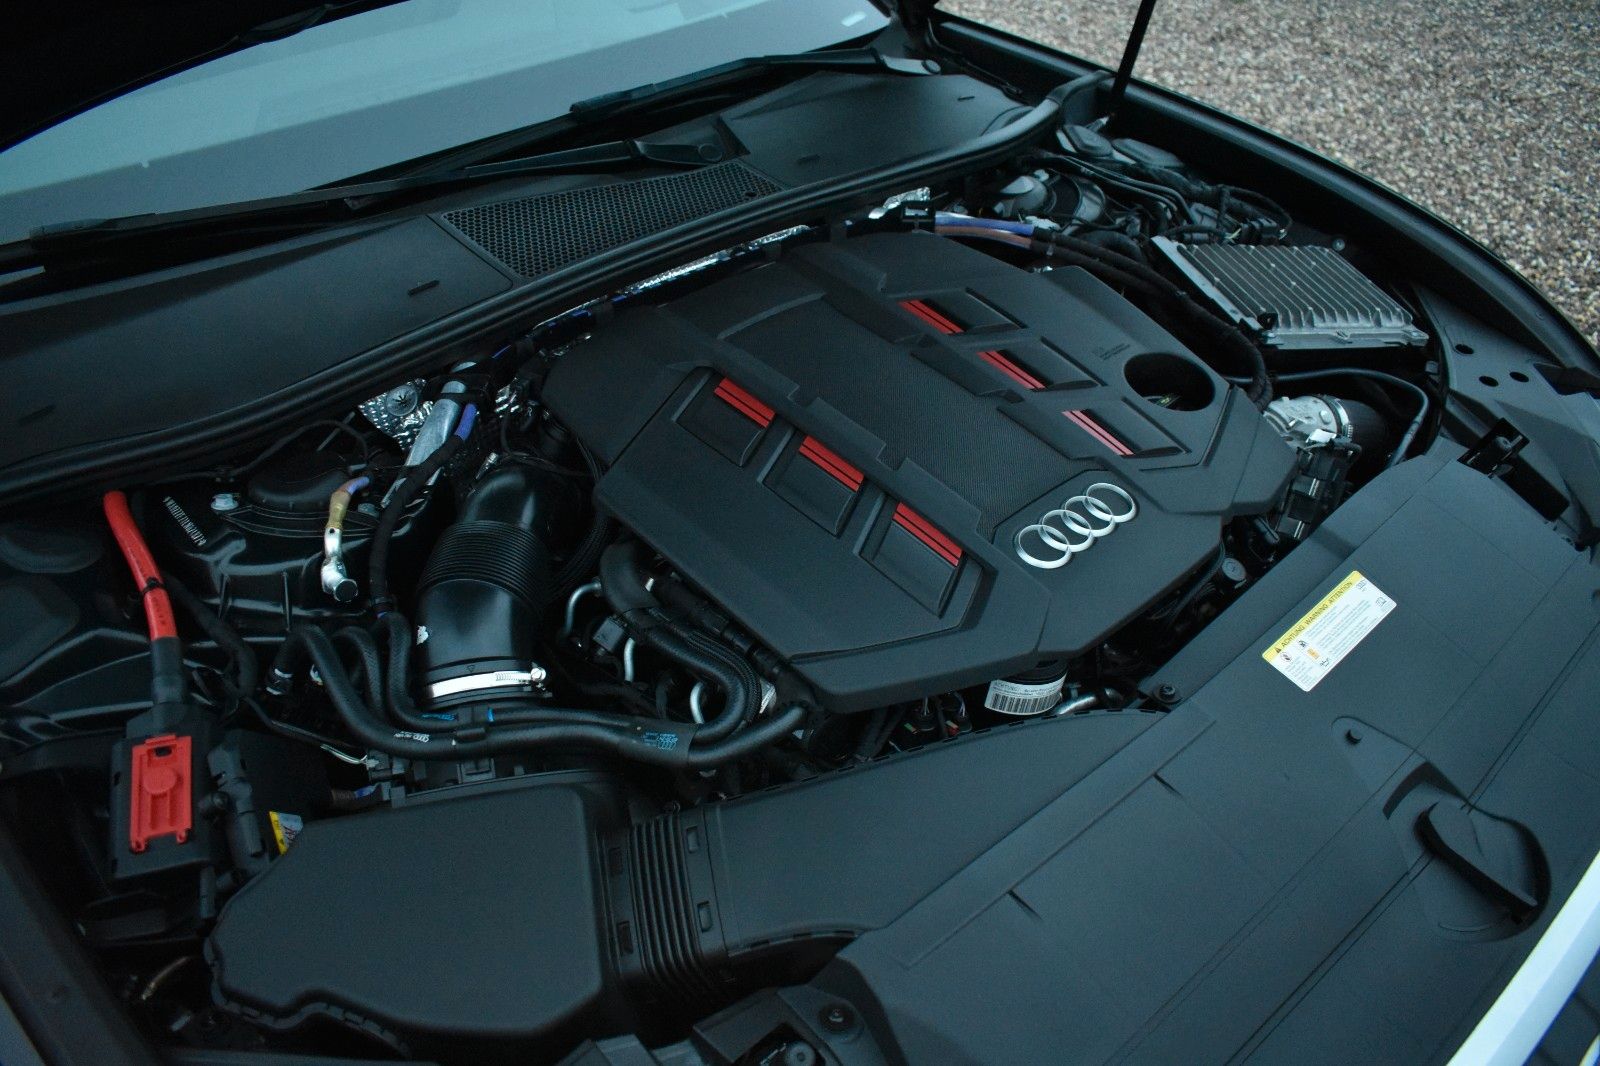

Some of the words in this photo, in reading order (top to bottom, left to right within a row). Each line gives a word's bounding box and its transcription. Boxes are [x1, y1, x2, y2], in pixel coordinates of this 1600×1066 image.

[1281, 626, 1305, 648] ACHTUNG
[1305, 603, 1329, 626] WARNING
[1328, 581, 1353, 605] ATTENTION
